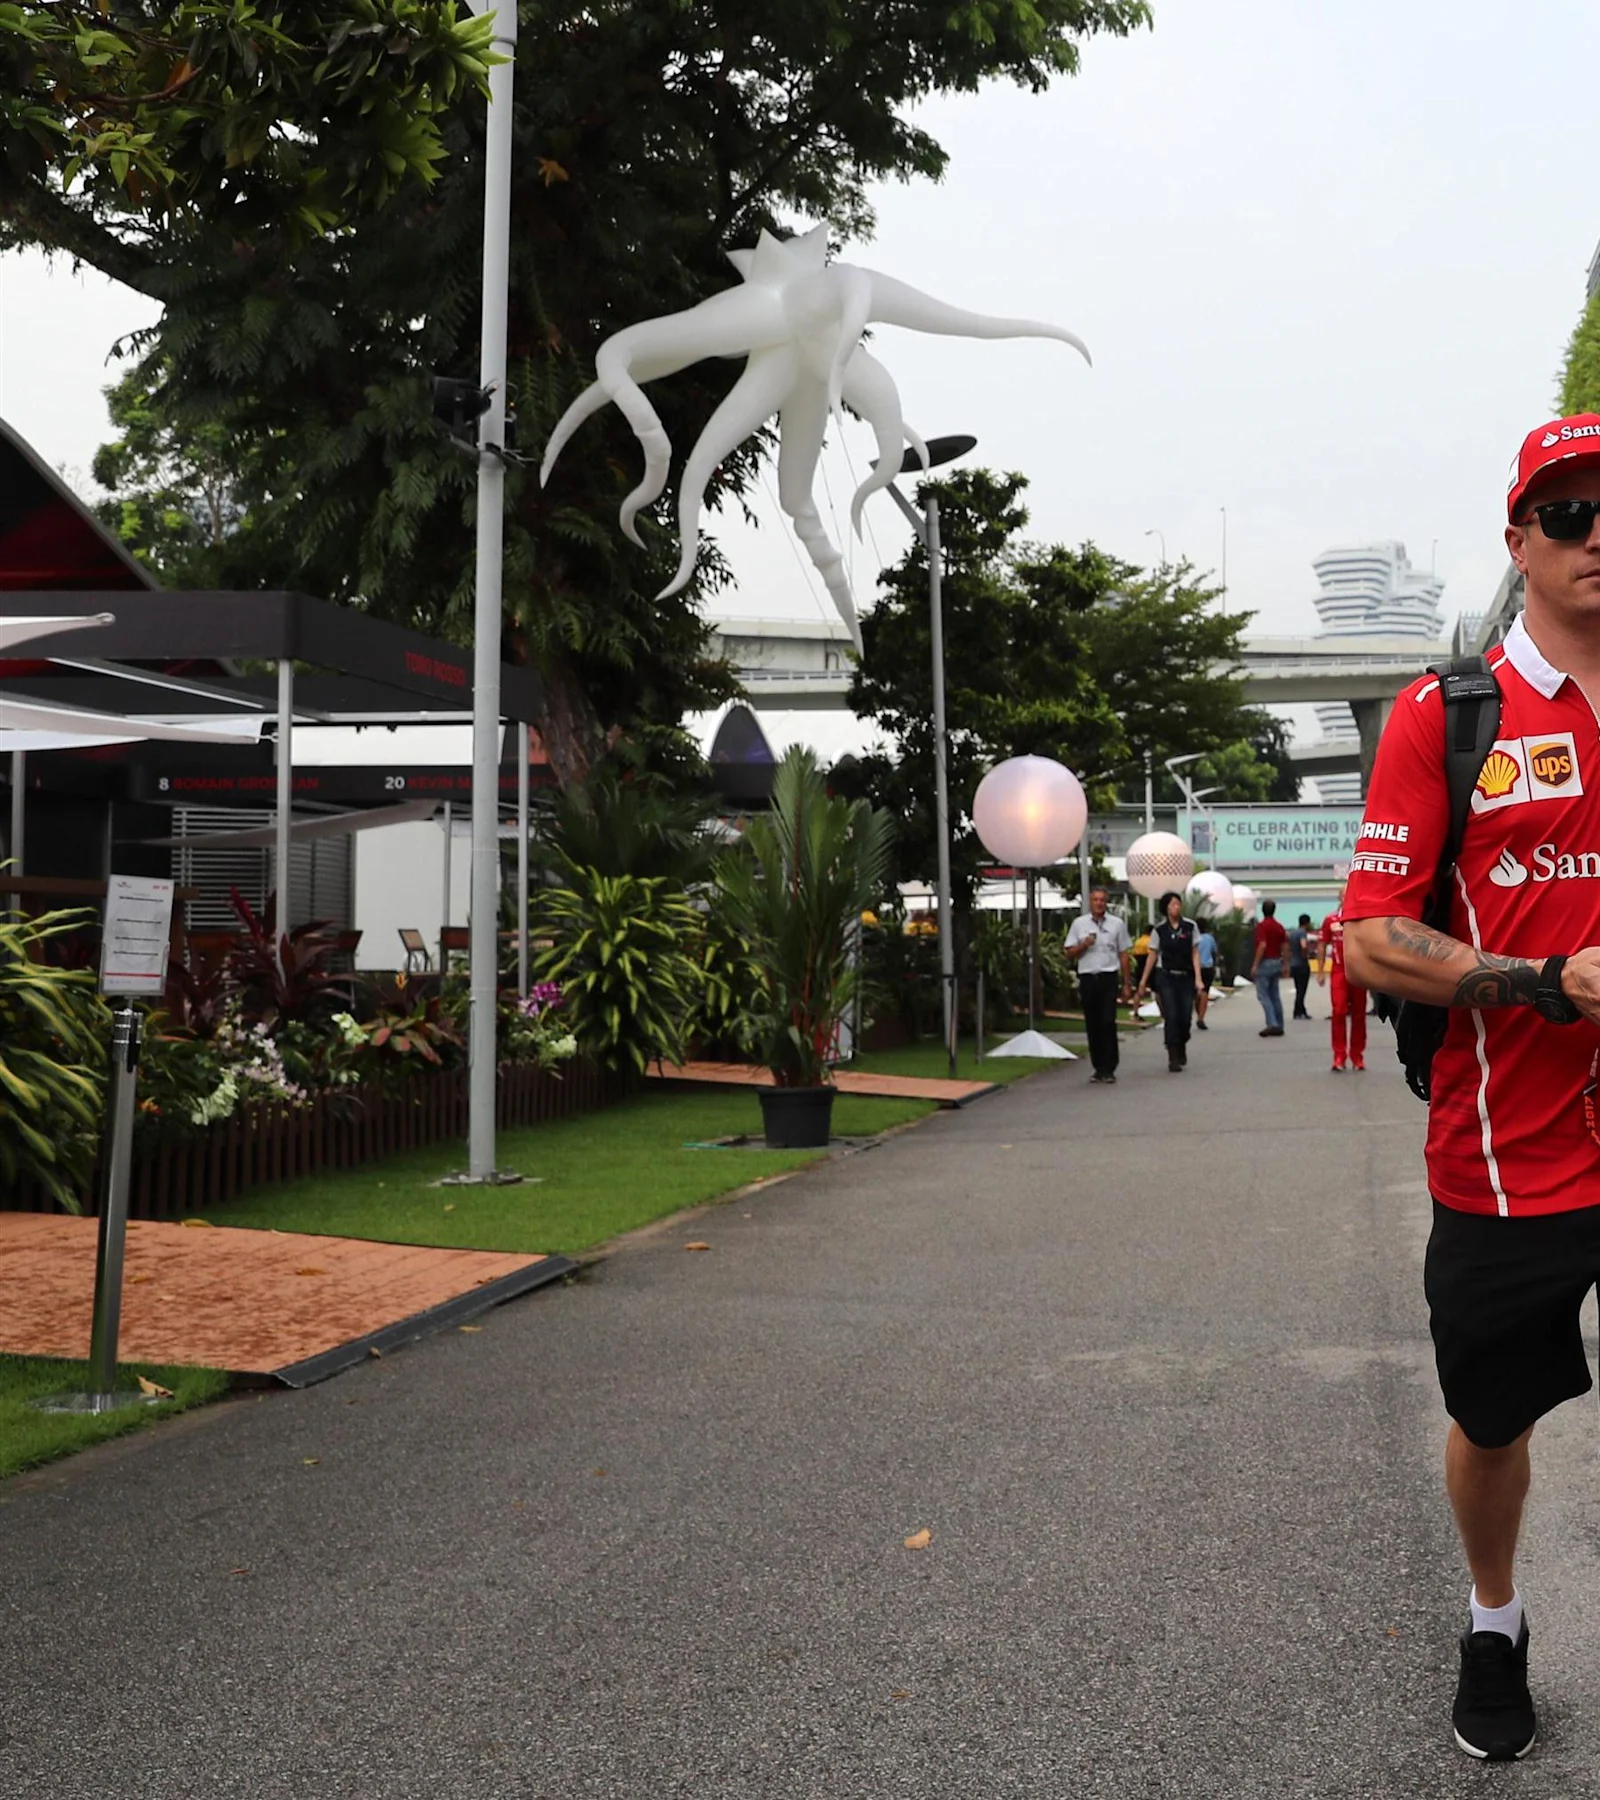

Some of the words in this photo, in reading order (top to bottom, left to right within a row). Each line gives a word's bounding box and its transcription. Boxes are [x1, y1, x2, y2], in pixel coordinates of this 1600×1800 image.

[1533, 754, 1572, 782] ups
[158, 777, 169, 791] 8
[384, 776, 405, 790] 20
[1226, 821, 1339, 836] CELEBRATING
[1253, 838, 1273, 852] OF
[1277, 837, 1326, 851] NIGHT
[1330, 837, 1356, 851] RA
